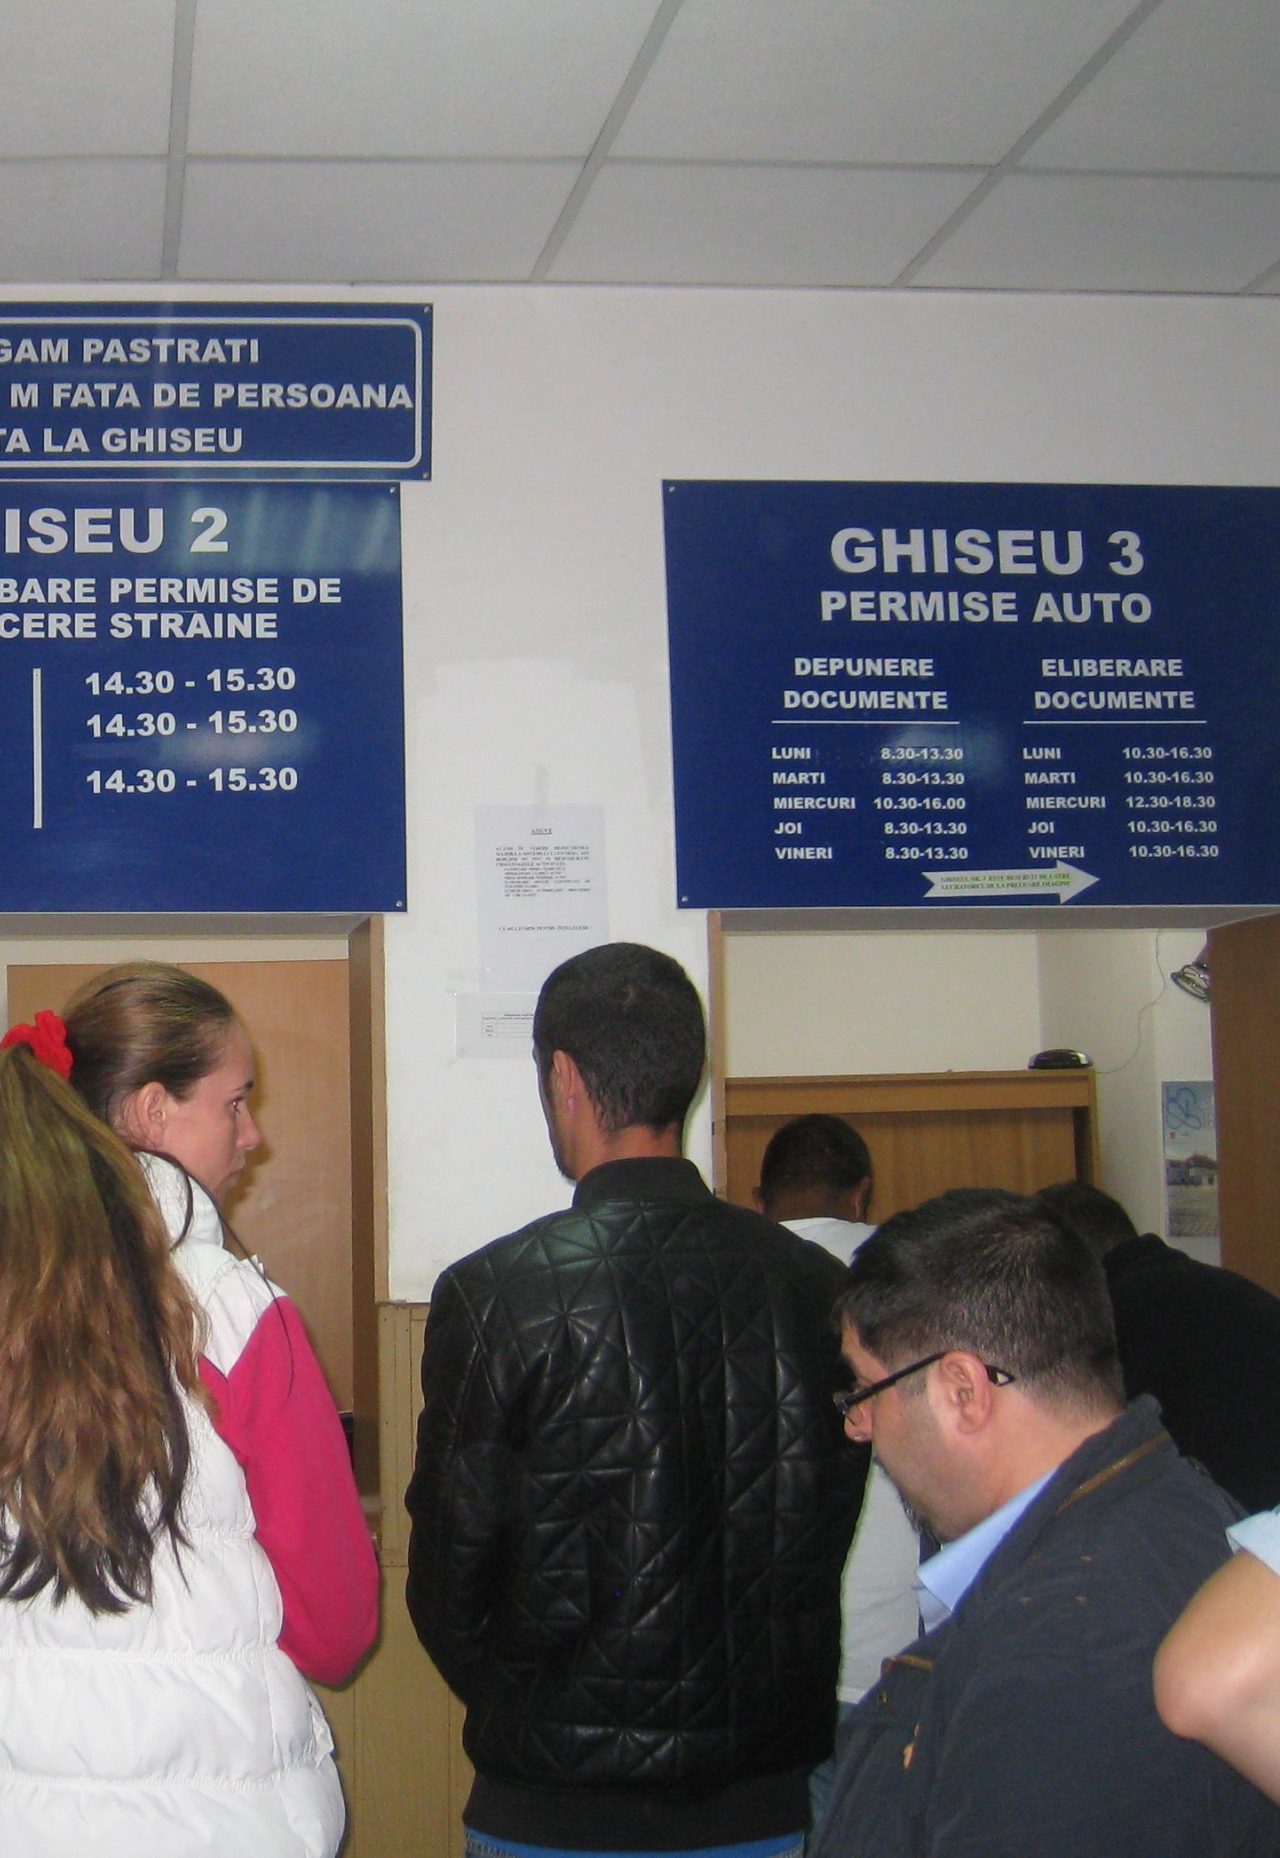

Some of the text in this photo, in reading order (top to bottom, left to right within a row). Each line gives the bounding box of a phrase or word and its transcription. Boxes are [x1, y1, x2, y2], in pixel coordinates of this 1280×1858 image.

[82, 338, 259, 364] PASTRATI
[10, 383, 39, 408] M
[52, 382, 141, 408] FATA
[153, 382, 200, 408] DE
[213, 383, 414, 409] PERSOANA
[43, 427, 90, 453] LA
[101, 427, 243, 453] GHISEU
[189, 507, 229, 553] 2
[830, 527, 1144, 576] GHISEU 3
[110, 577, 279, 604] PERMISE
[292, 577, 342, 604] DE
[820, 590, 1152, 624] PERMISE AUTO
[109, 612, 278, 639] STRAINE
[794, 657, 935, 677] DEPUNERE
[1041, 658, 1184, 677] ELIBERARE
[85, 670, 175, 696] 14.30
[206, 667, 296, 692] 15.30
[783, 690, 948, 710] DOCUMENTE
[1034, 690, 1195, 710] DOCUMENTE
[86, 712, 176, 738] 14.30
[208, 708, 298, 735] 15.30
[771, 747, 964, 761] LUNI 8.30-13.30
[1022, 746, 1213, 760] LUNI 10.30-16.30
[86, 769, 176, 794] 14.30
[208, 767, 298, 792] 15.30
[772, 772, 965, 785] MARTI 8.30-13.30
[1024, 771, 1215, 785] MARTI 10.30-16.30
[773, 796, 966, 810] MIERCURI 10.30-16.00
[1026, 795, 1216, 809] MIERCURI 12.30-18.30
[774, 821, 968, 835] JOI 8.30-13.30
[1027, 820, 1218, 834] JOI 10.30-16.30
[774, 846, 969, 860] VINERI 8.30-13.30
[1028, 844, 1219, 859] VINERI 10.30-16.30
